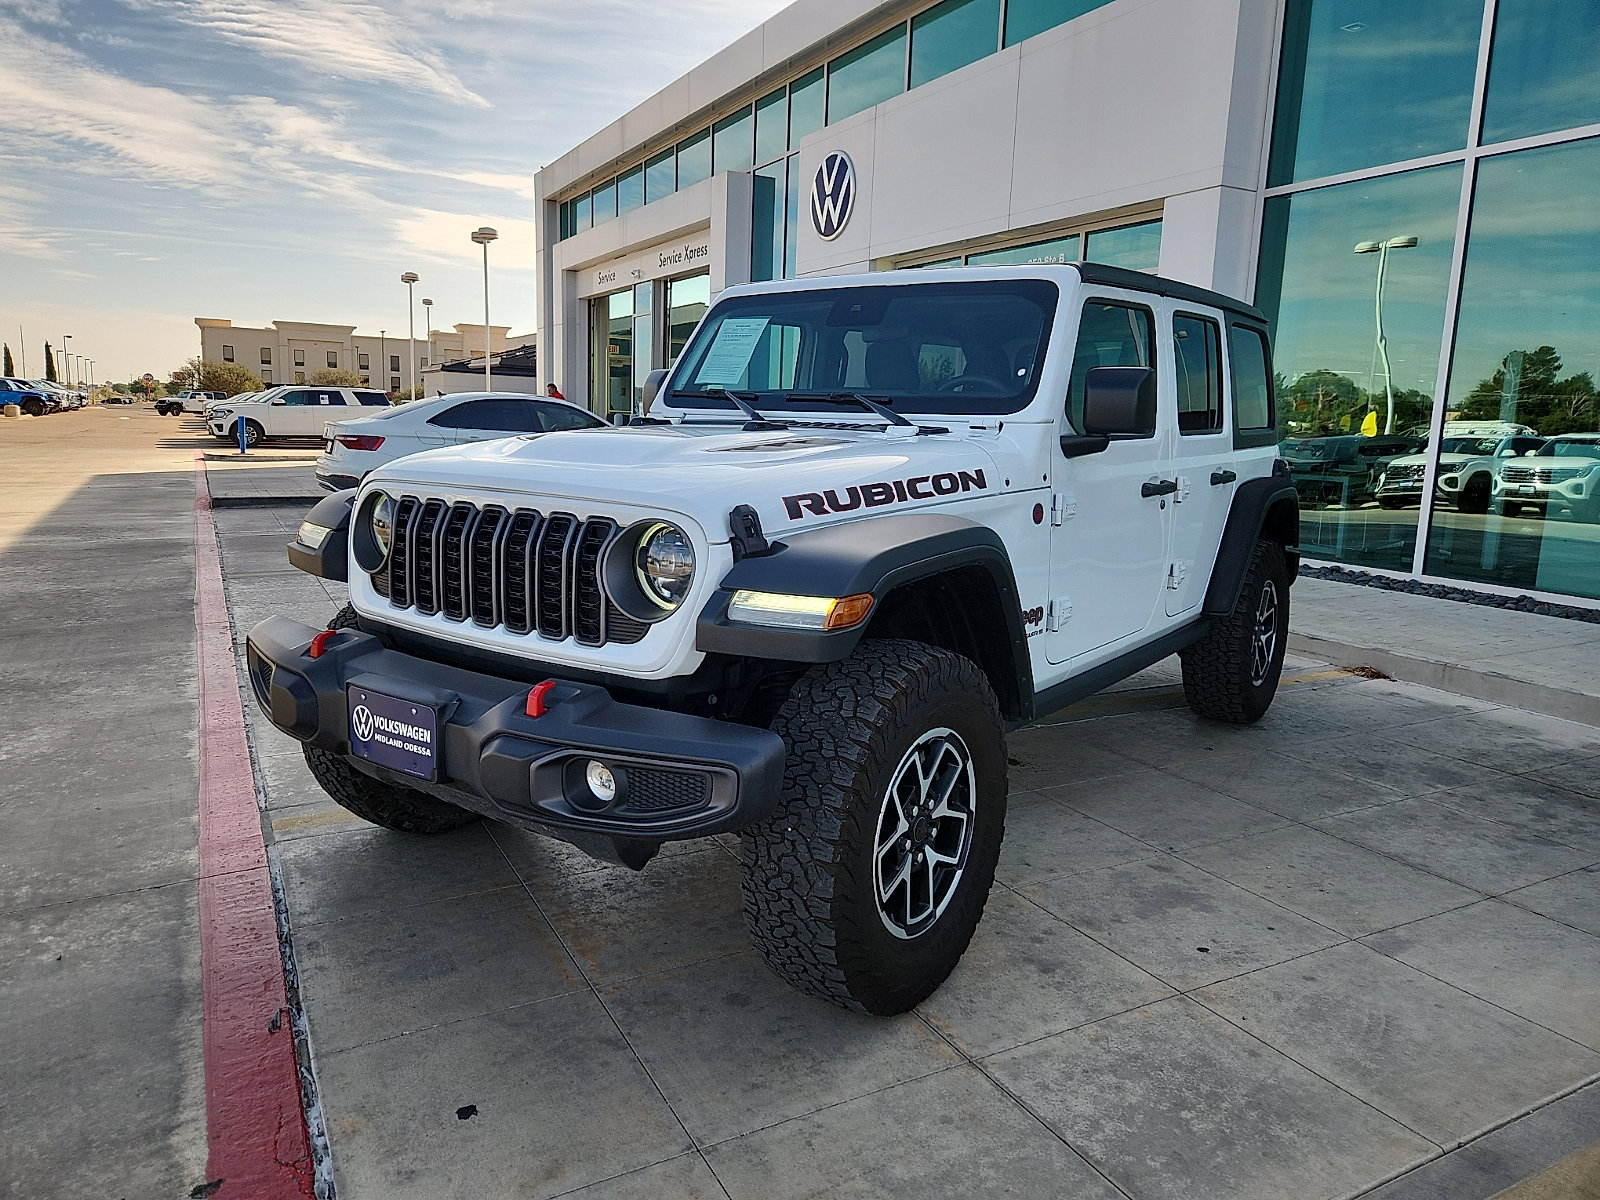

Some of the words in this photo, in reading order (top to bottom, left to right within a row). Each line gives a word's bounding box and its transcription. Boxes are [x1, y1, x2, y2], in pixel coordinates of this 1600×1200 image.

[659, 250, 682, 268] Service
[684, 245, 708, 263] Xpress
[1059, 253, 1065, 263] B
[598, 270, 616, 285] Service
[782, 468, 988, 521] RUBICON
[1022, 605, 1044, 627] eep
[374, 715, 431, 743] VOLKSWAGEN
[374, 732, 403, 749] MIDLAND
[404, 742, 432, 757] ODESSA
